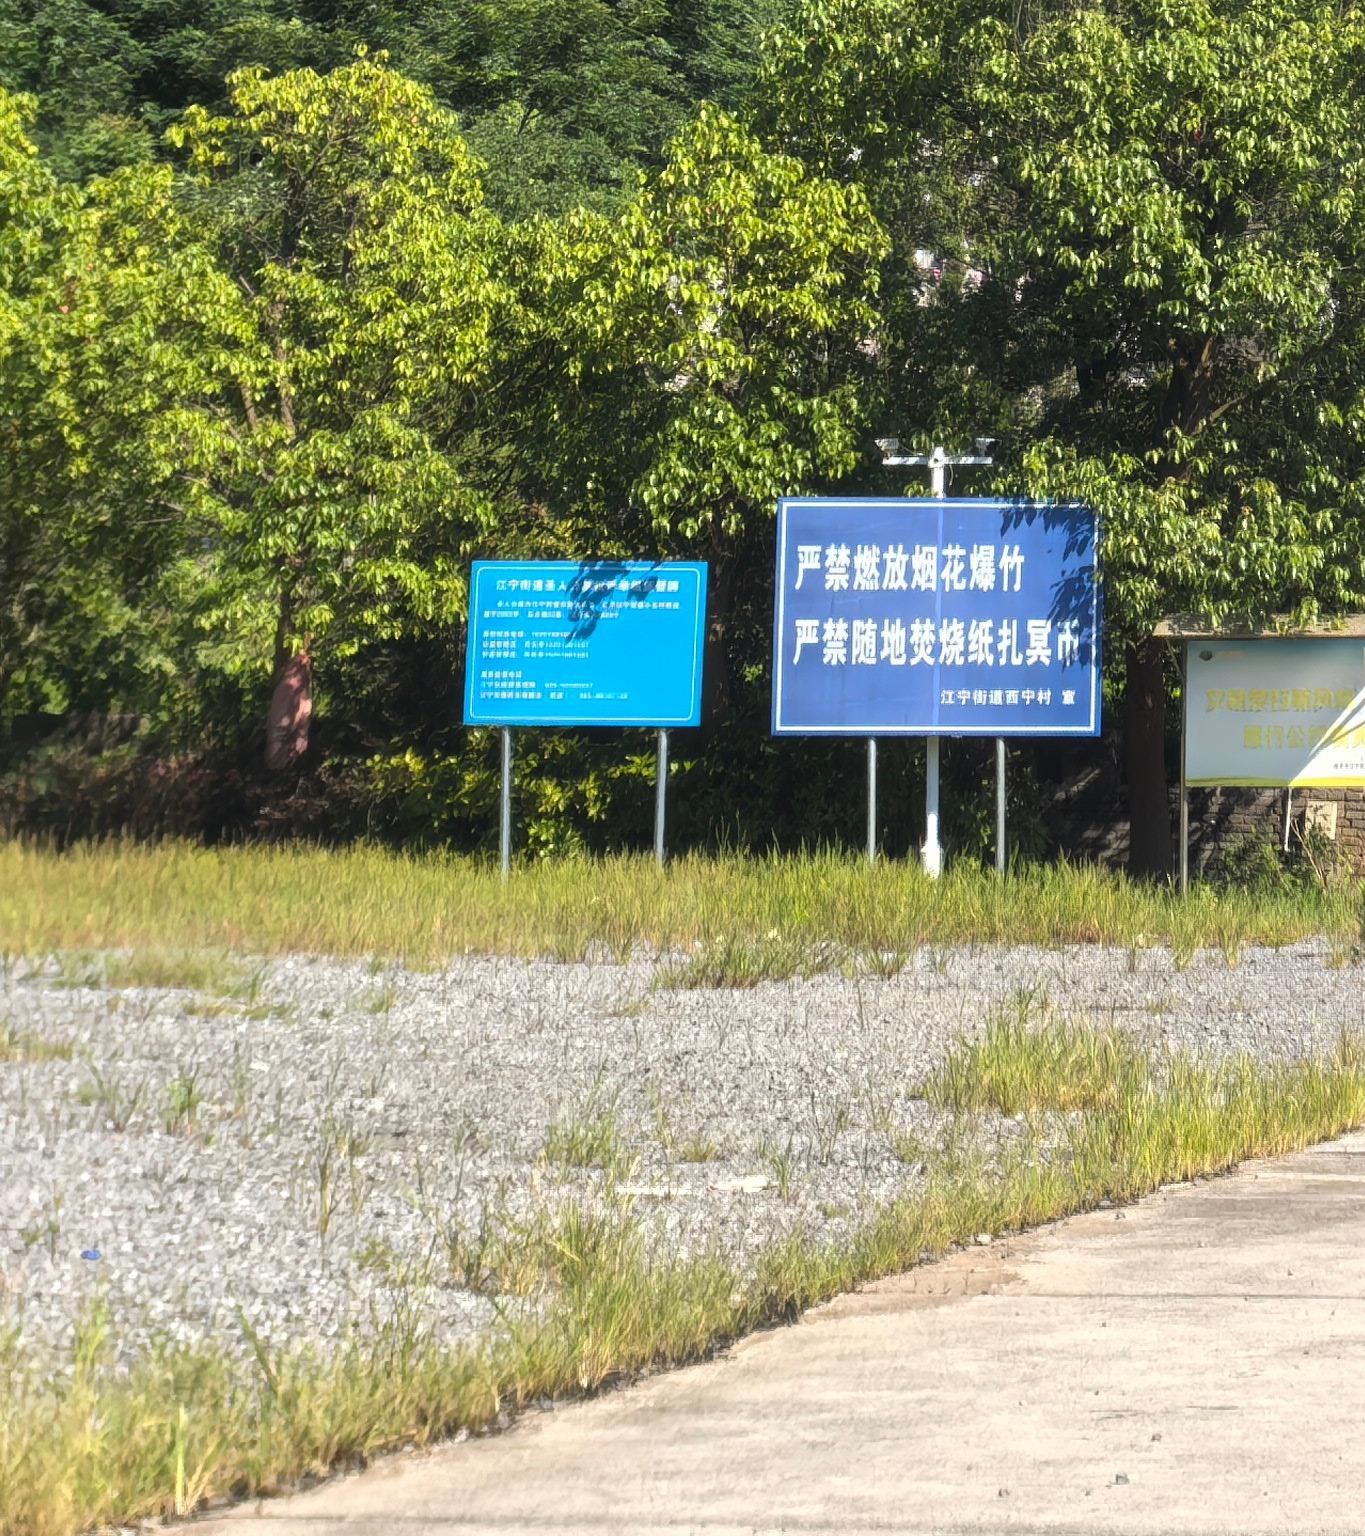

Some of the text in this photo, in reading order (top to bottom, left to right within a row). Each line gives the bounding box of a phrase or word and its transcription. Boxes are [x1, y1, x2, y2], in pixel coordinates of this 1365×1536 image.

[795, 543, 1025, 591] 严禁燃放烟花爆竹
[793, 617, 1081, 666] 严禁随地焚烧纸扎冥币
[940, 688, 1052, 706] 江宁街道西宁村
